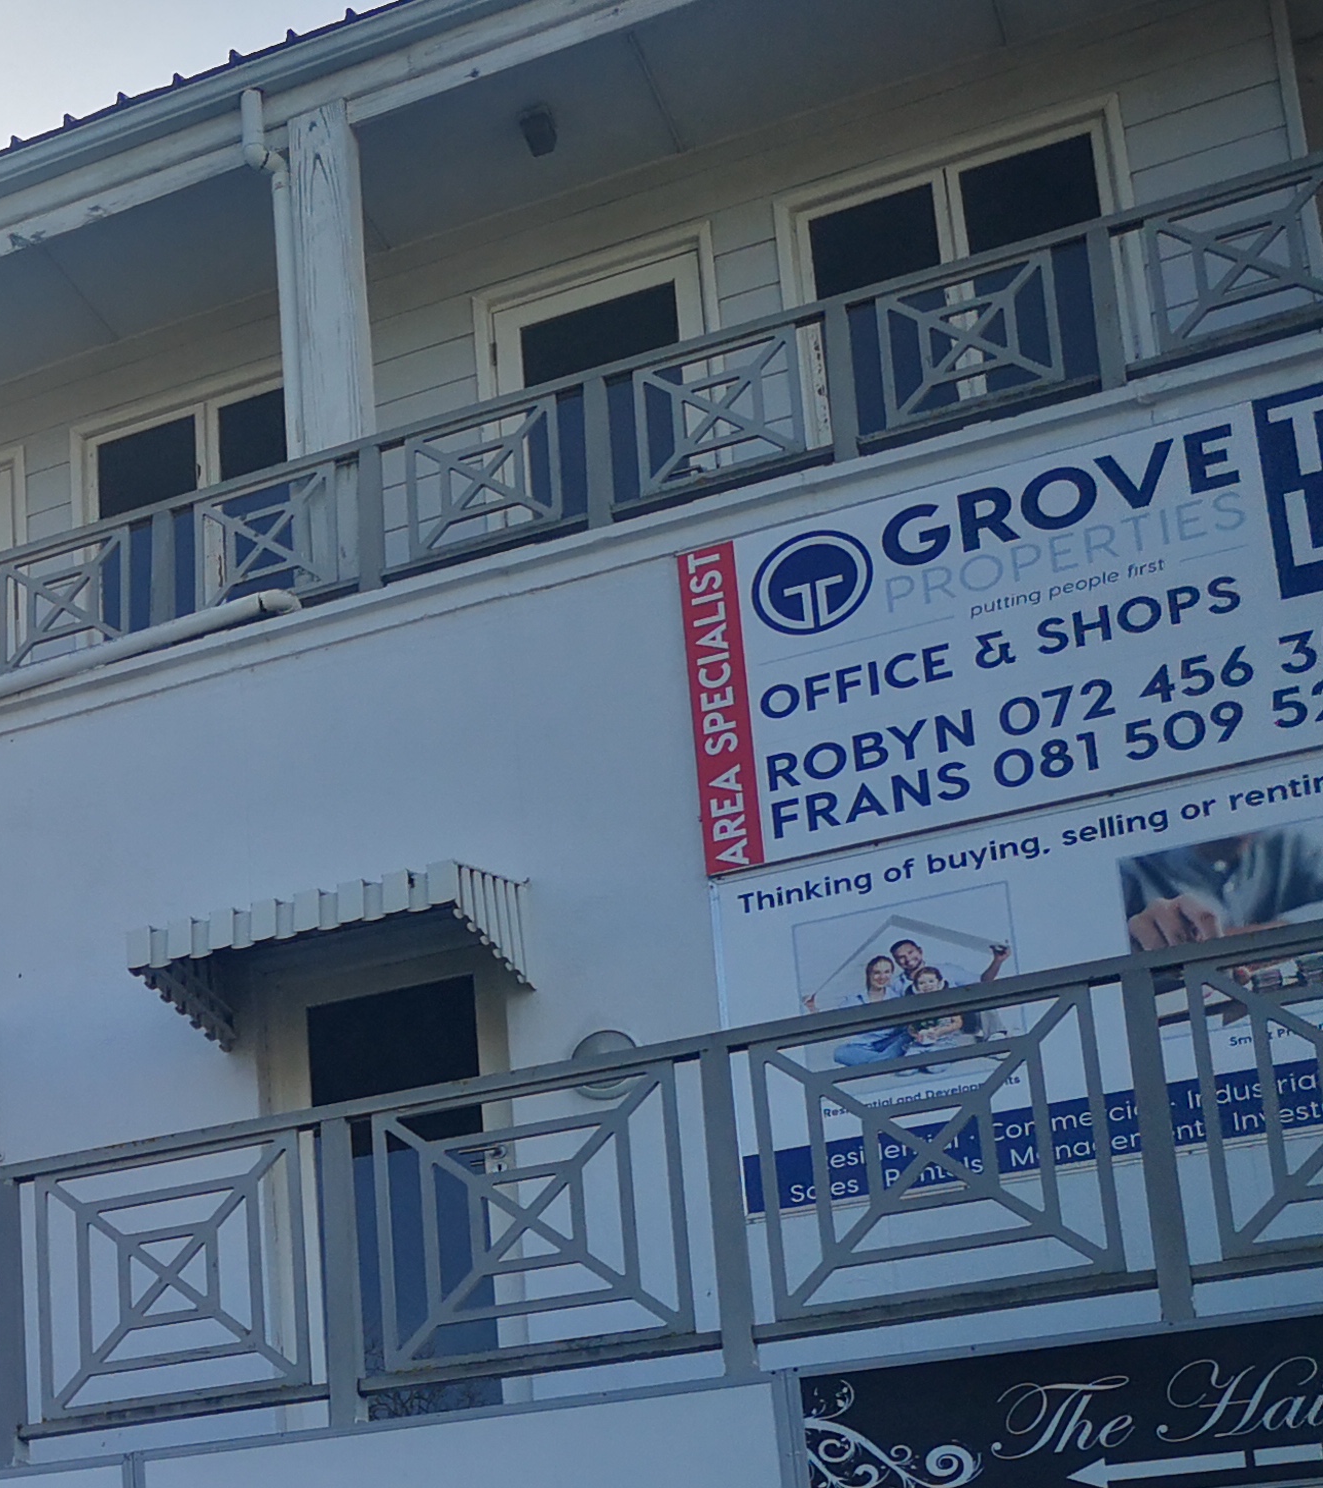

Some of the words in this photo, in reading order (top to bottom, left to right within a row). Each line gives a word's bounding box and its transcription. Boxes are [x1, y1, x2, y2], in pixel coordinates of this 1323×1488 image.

[882, 423, 1241, 566] GROVE
[885, 491, 1245, 613] PROPERTIES
[686, 550, 739, 756] SPECIALIST
[759, 643, 955, 720] OFFICE
[974, 630, 1017, 668] &
[1037, 576, 1242, 655] SHOPS
[970, 588, 1041, 619] putting
[1048, 569, 1120, 604] people
[1128, 557, 1166, 578] first
[766, 708, 977, 792] ROBYN
[999, 678, 1116, 736] 072
[1139, 645, 1254, 703] 456
[771, 761, 973, 840] FRANS
[993, 731, 1100, 788] 081
[1125, 701, 1244, 761] 509
[709, 764, 751, 866] AREA
[738, 871, 873, 913] Thinking
[884, 858, 915, 883] of
[1062, 809, 1170, 846] selling
[1180, 799, 1216, 820] or
[991, 1375, 1136, 1460] The
